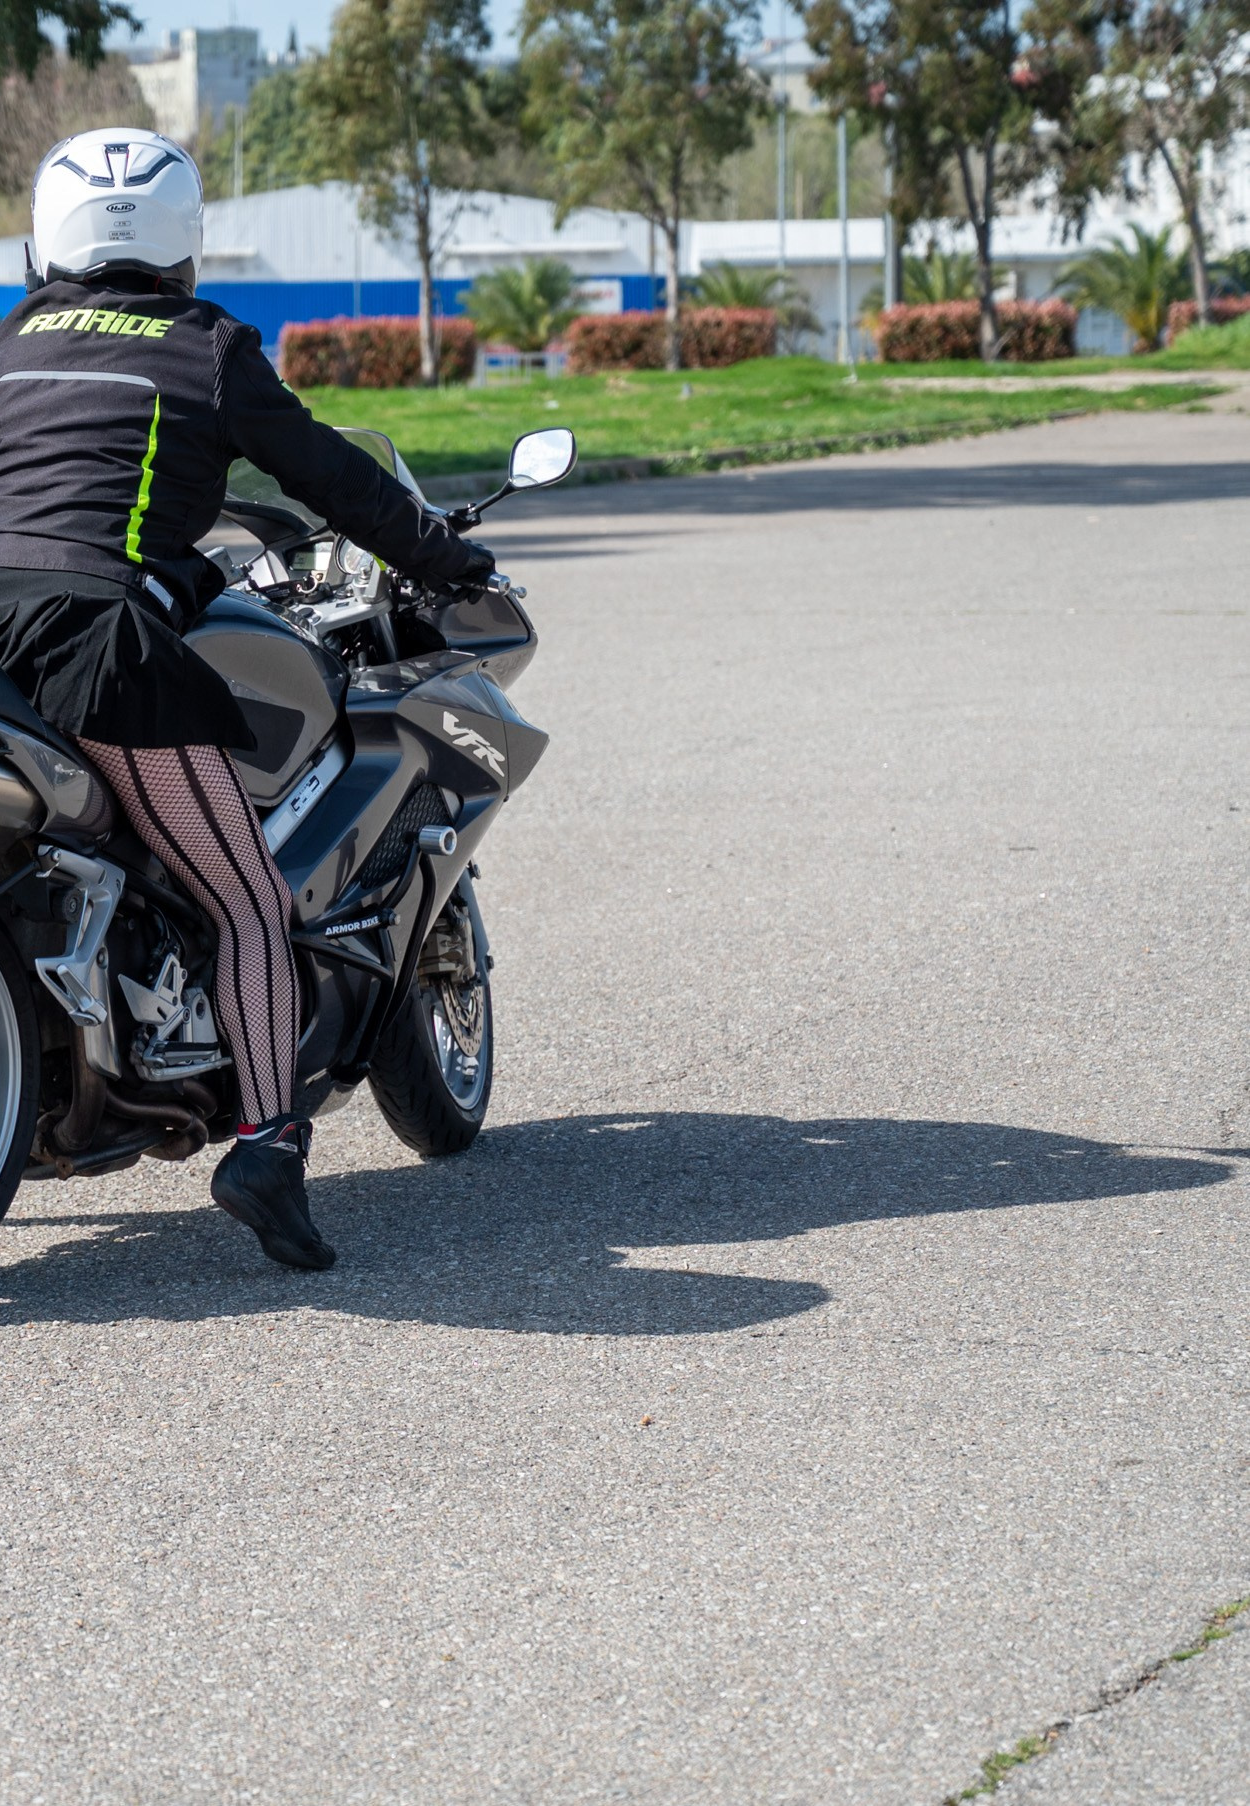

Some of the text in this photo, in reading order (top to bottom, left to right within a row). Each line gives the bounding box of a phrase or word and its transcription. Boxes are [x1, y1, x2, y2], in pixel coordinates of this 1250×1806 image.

[442, 711, 506, 778] VFR
[324, 915, 380, 936] ARMOR BIKE
